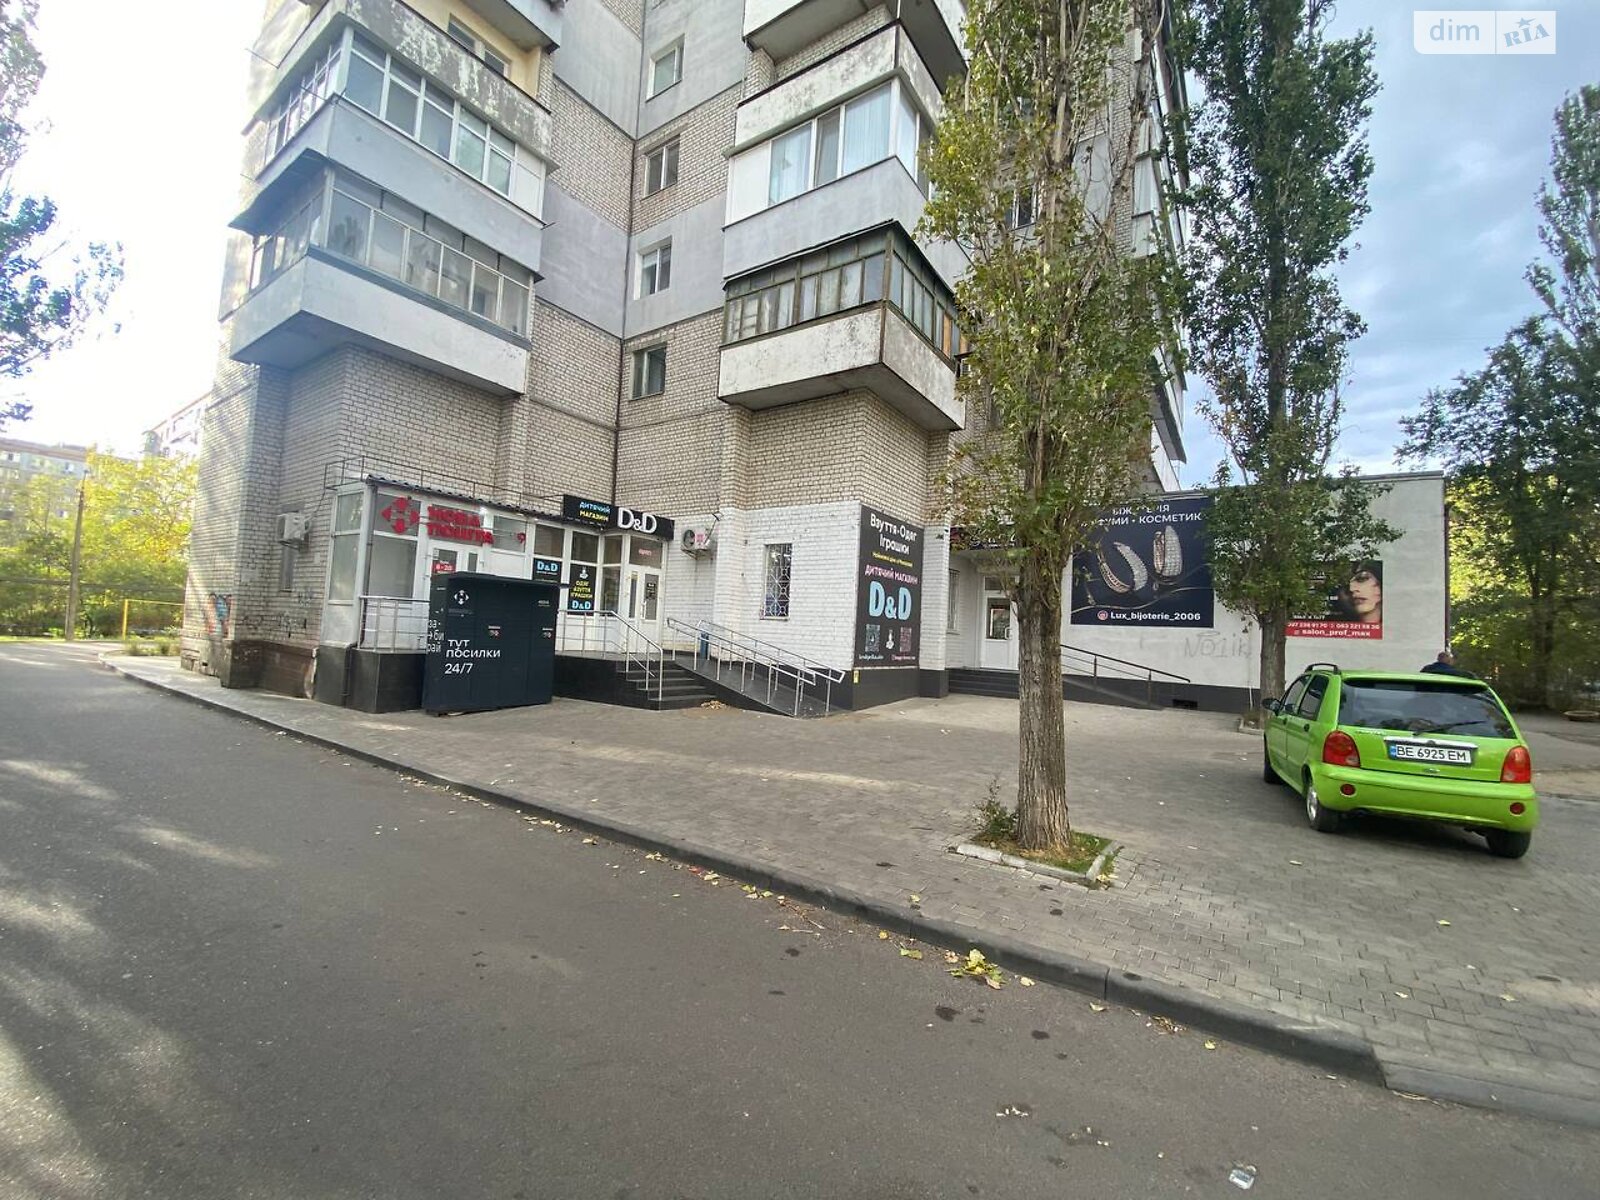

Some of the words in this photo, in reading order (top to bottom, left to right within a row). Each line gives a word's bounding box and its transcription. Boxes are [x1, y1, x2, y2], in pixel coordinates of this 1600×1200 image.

[579, 510, 609, 522] МАГАЗИН
[617, 507, 657, 534] D&D
[536, 561, 558, 572] D&D
[571, 600, 591, 610] D&D
[869, 580, 912, 620] D&D
[1110, 611, 1201, 622] Lux_bijoterie_2006
[447, 639, 470, 651] тут
[446, 649, 501, 658] посилки
[444, 662, 474, 675] 24/7
[1397, 747, 1413, 757] BE
[1417, 748, 1445, 760] 6925
[1448, 750, 1466, 761] EM
